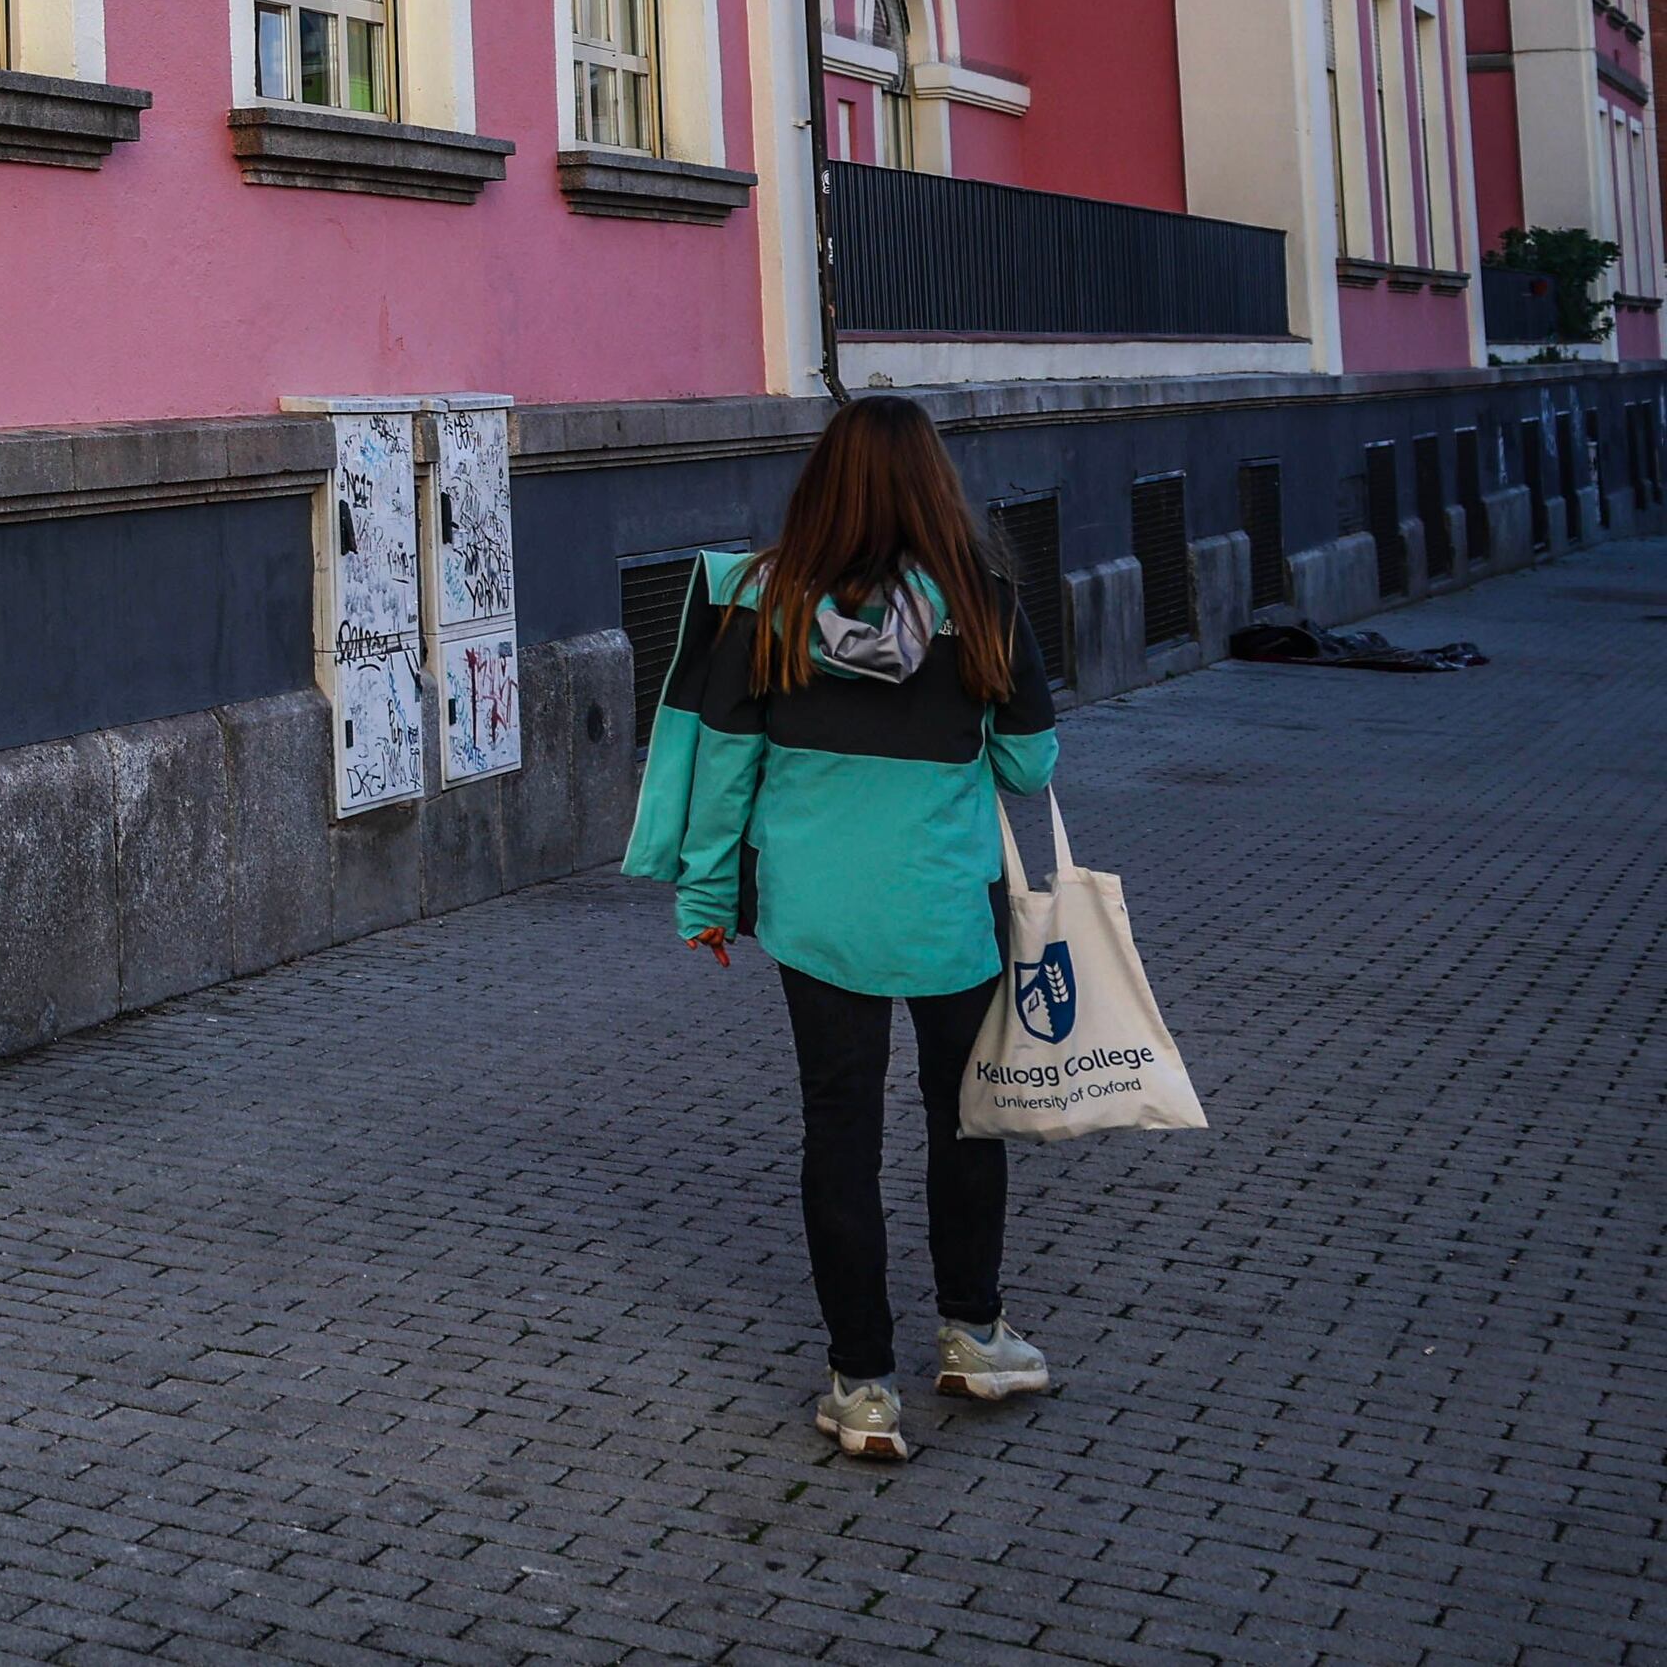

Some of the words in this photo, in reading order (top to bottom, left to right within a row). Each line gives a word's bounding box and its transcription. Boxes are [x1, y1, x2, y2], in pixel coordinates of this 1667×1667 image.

[976, 1061, 1060, 1087] Kellogg
[1064, 1047, 1154, 1077] College
[994, 1095, 1068, 1111] University
[1069, 1087, 1084, 1103] of
[1087, 1078, 1142, 1098] Oxford
